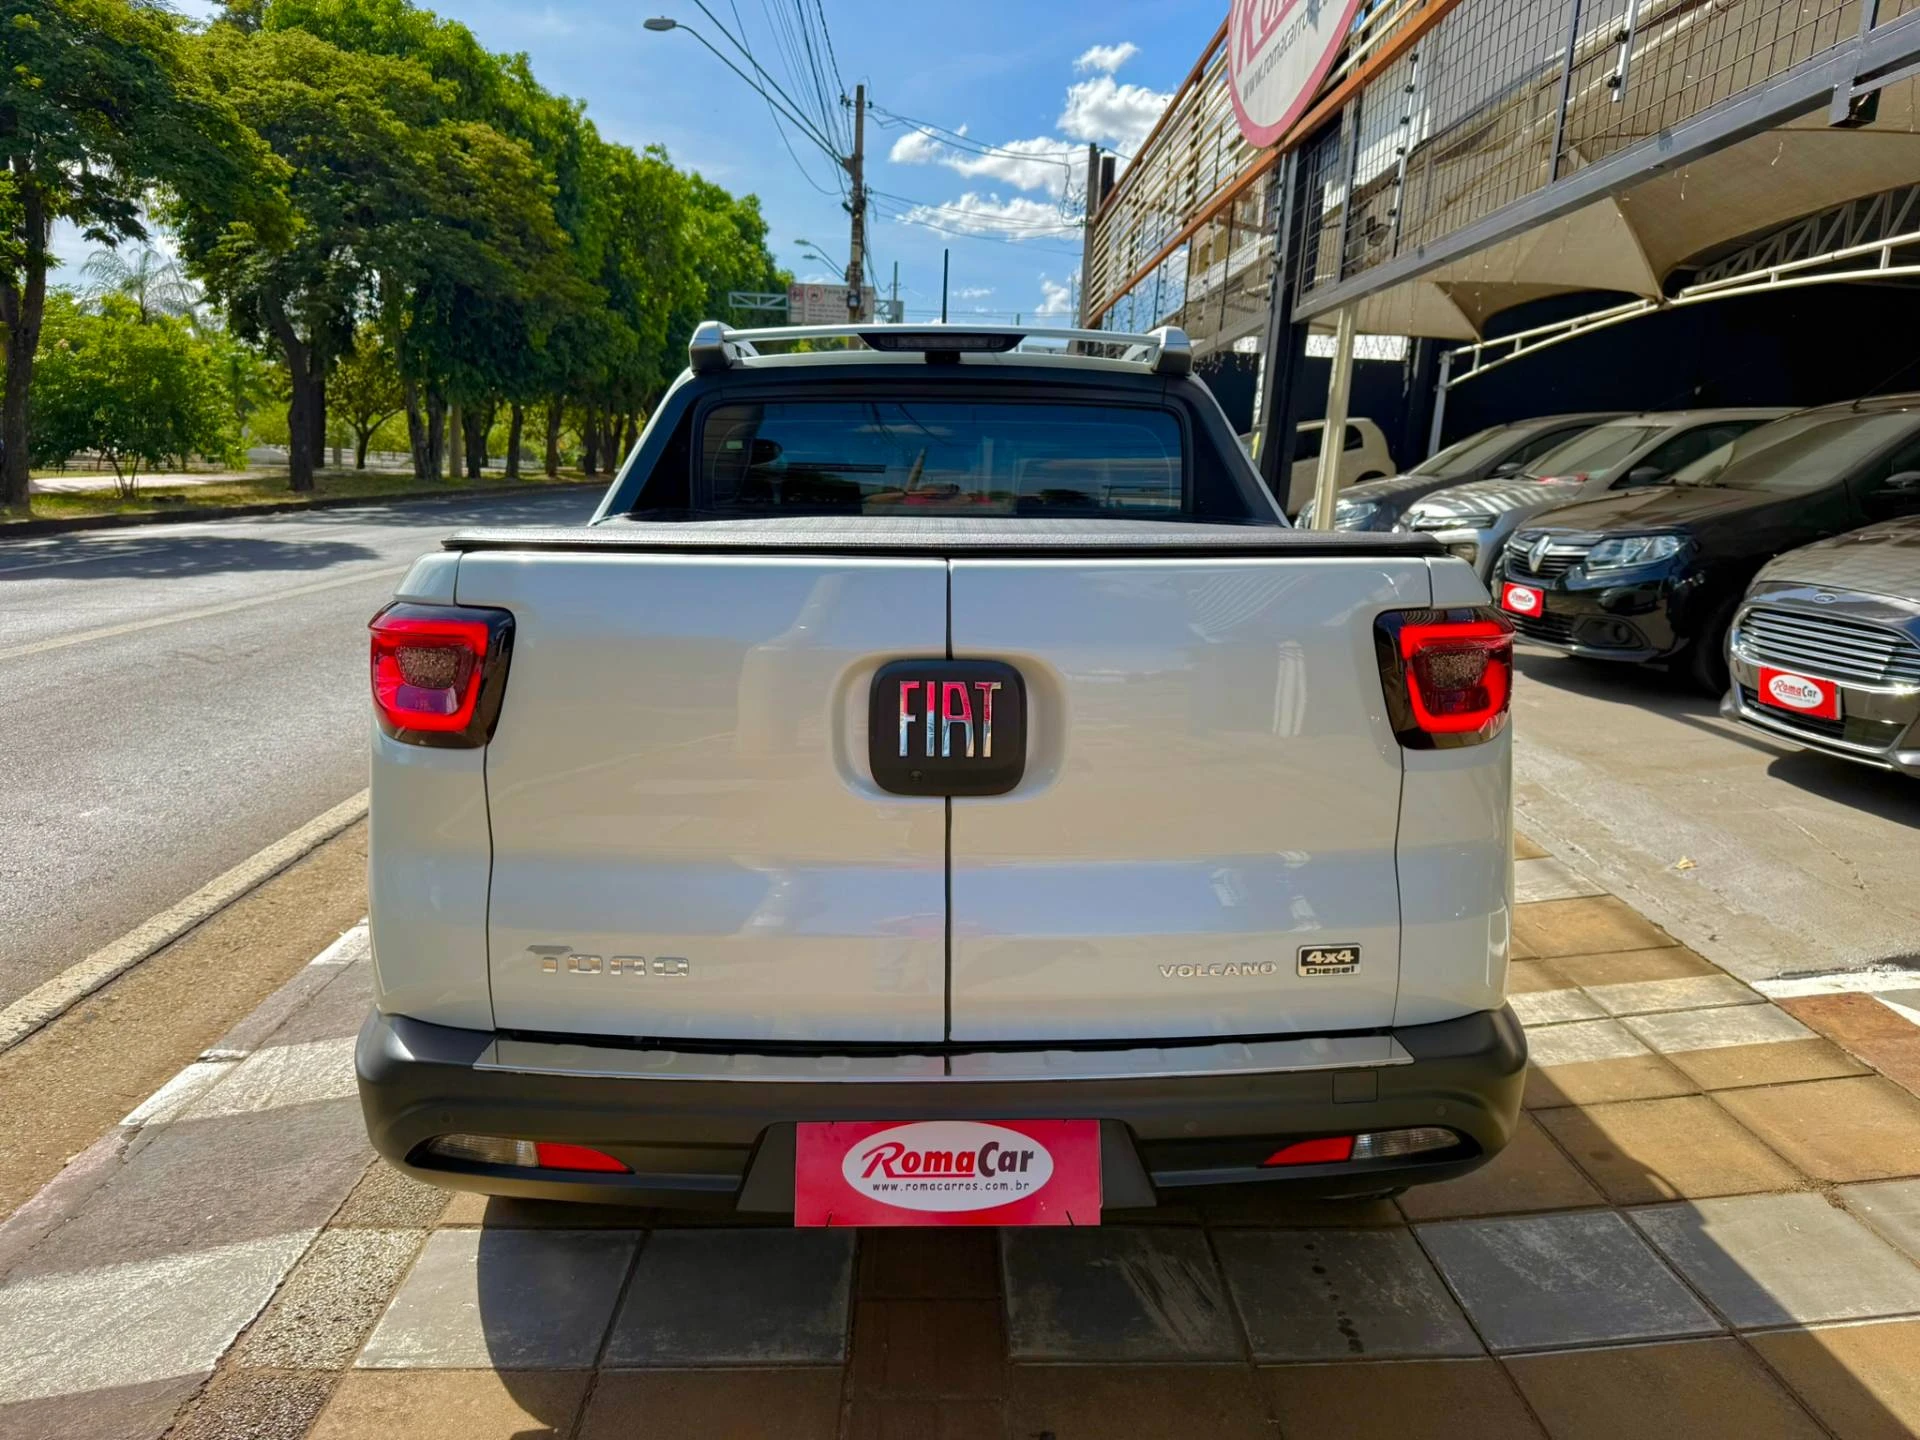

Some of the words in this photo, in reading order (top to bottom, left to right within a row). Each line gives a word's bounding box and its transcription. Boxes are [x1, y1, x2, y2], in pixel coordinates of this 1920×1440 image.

[1773, 680, 1817, 698] RomaCar
[899, 680, 1002, 758] FIAT
[526, 944, 690, 977] TORO
[1306, 950, 1355, 965] 4x4
[1159, 961, 1278, 978] VOLCANO
[1305, 965, 1355, 976] Diesel
[861, 1141, 1034, 1179] RomaCar
[872, 1180, 1030, 1192] www.romacarros.com.br
